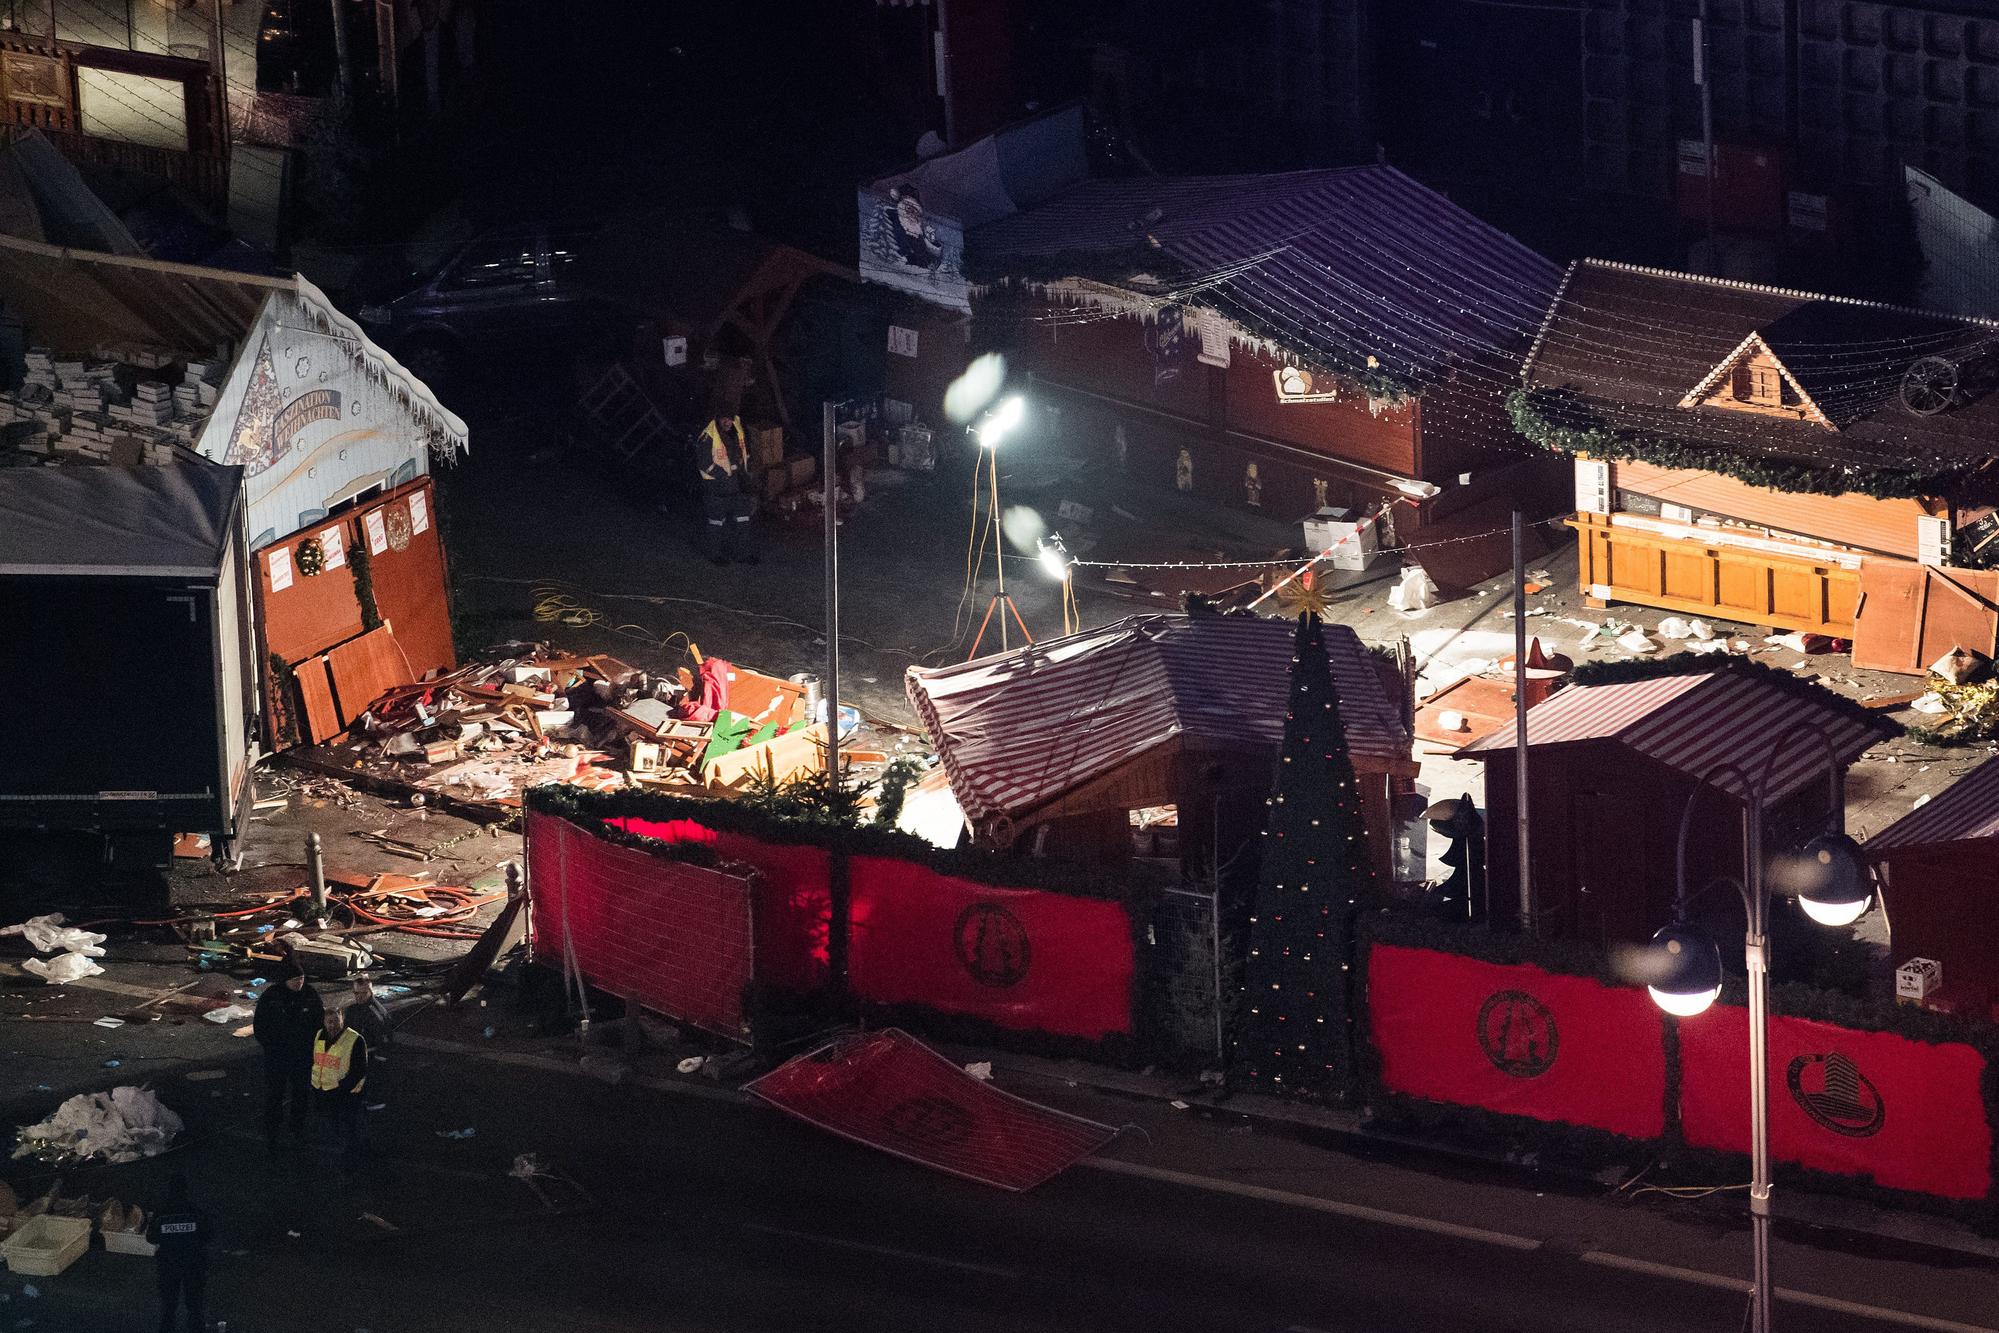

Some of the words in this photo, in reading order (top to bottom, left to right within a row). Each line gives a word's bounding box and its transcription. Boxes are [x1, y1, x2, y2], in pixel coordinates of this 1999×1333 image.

[274, 391, 331, 437] FASZINATION
[276, 405, 341, 449] WEIHNACHTEN
[164, 1223, 193, 1233] POLIZEI
